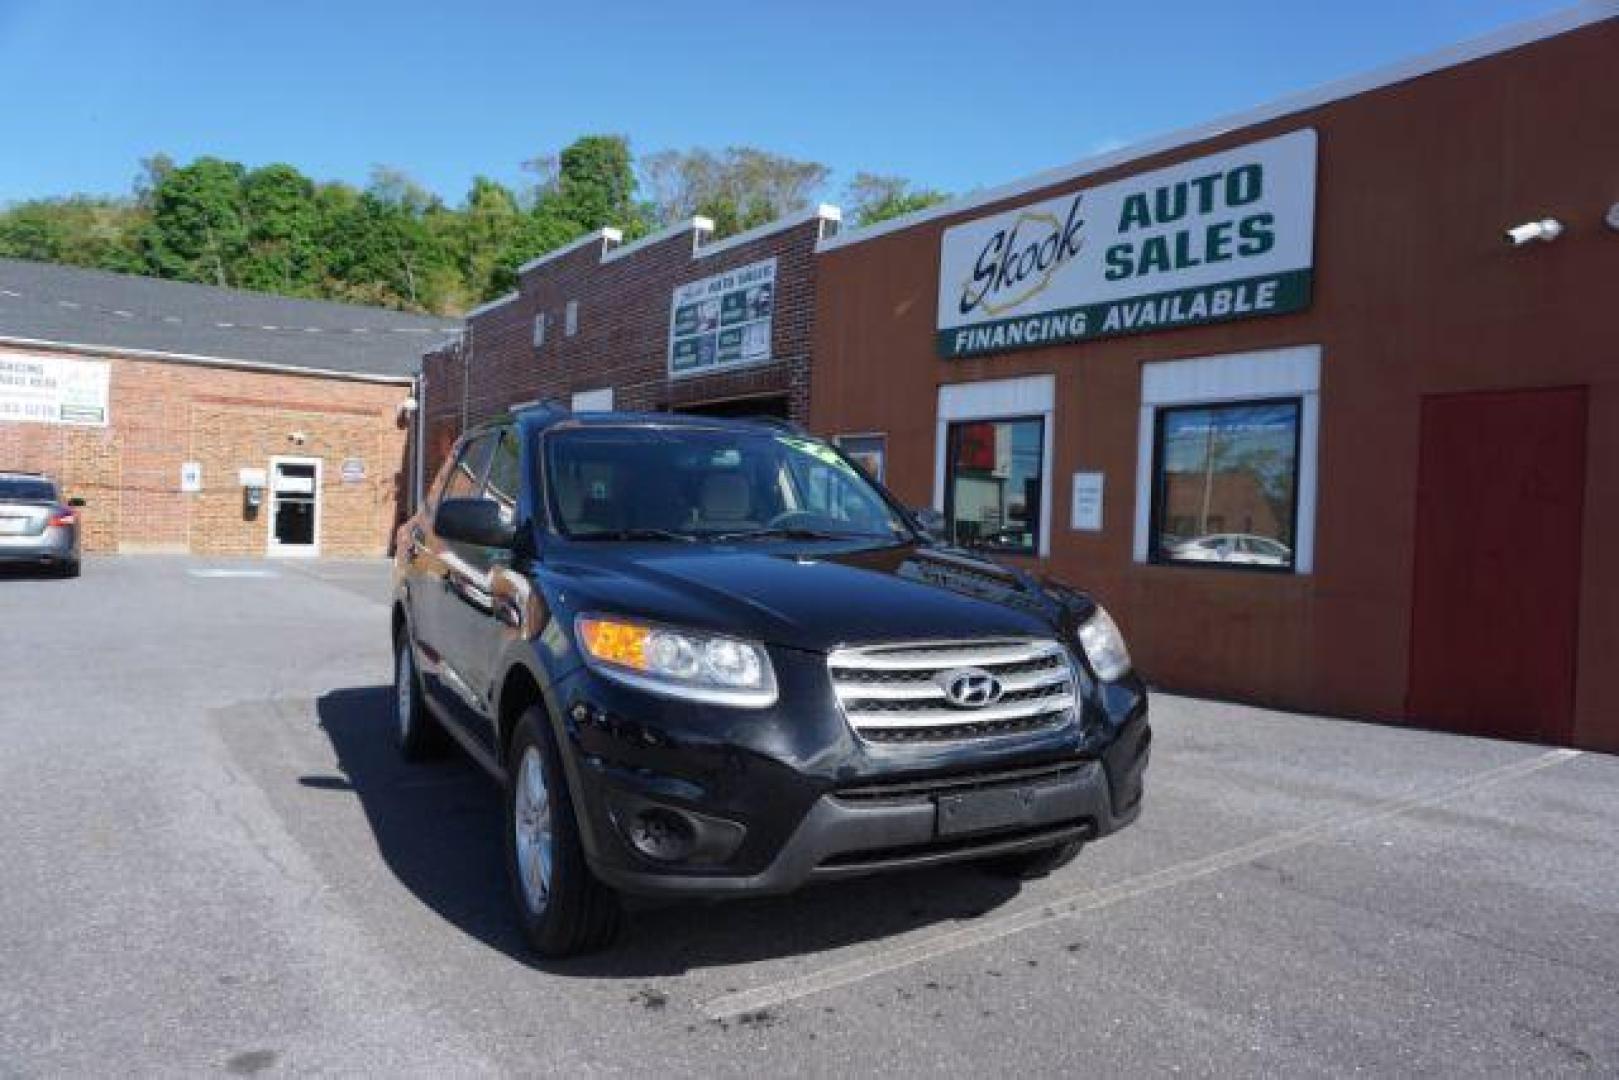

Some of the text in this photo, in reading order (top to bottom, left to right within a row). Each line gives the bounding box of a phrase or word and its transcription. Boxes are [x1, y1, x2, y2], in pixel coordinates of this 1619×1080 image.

[1118, 164, 1263, 233] AUTO
[961, 196, 1085, 314] Skook
[1105, 213, 1276, 281] SALES
[956, 281, 1278, 352] FINANCING AVAILABLE
